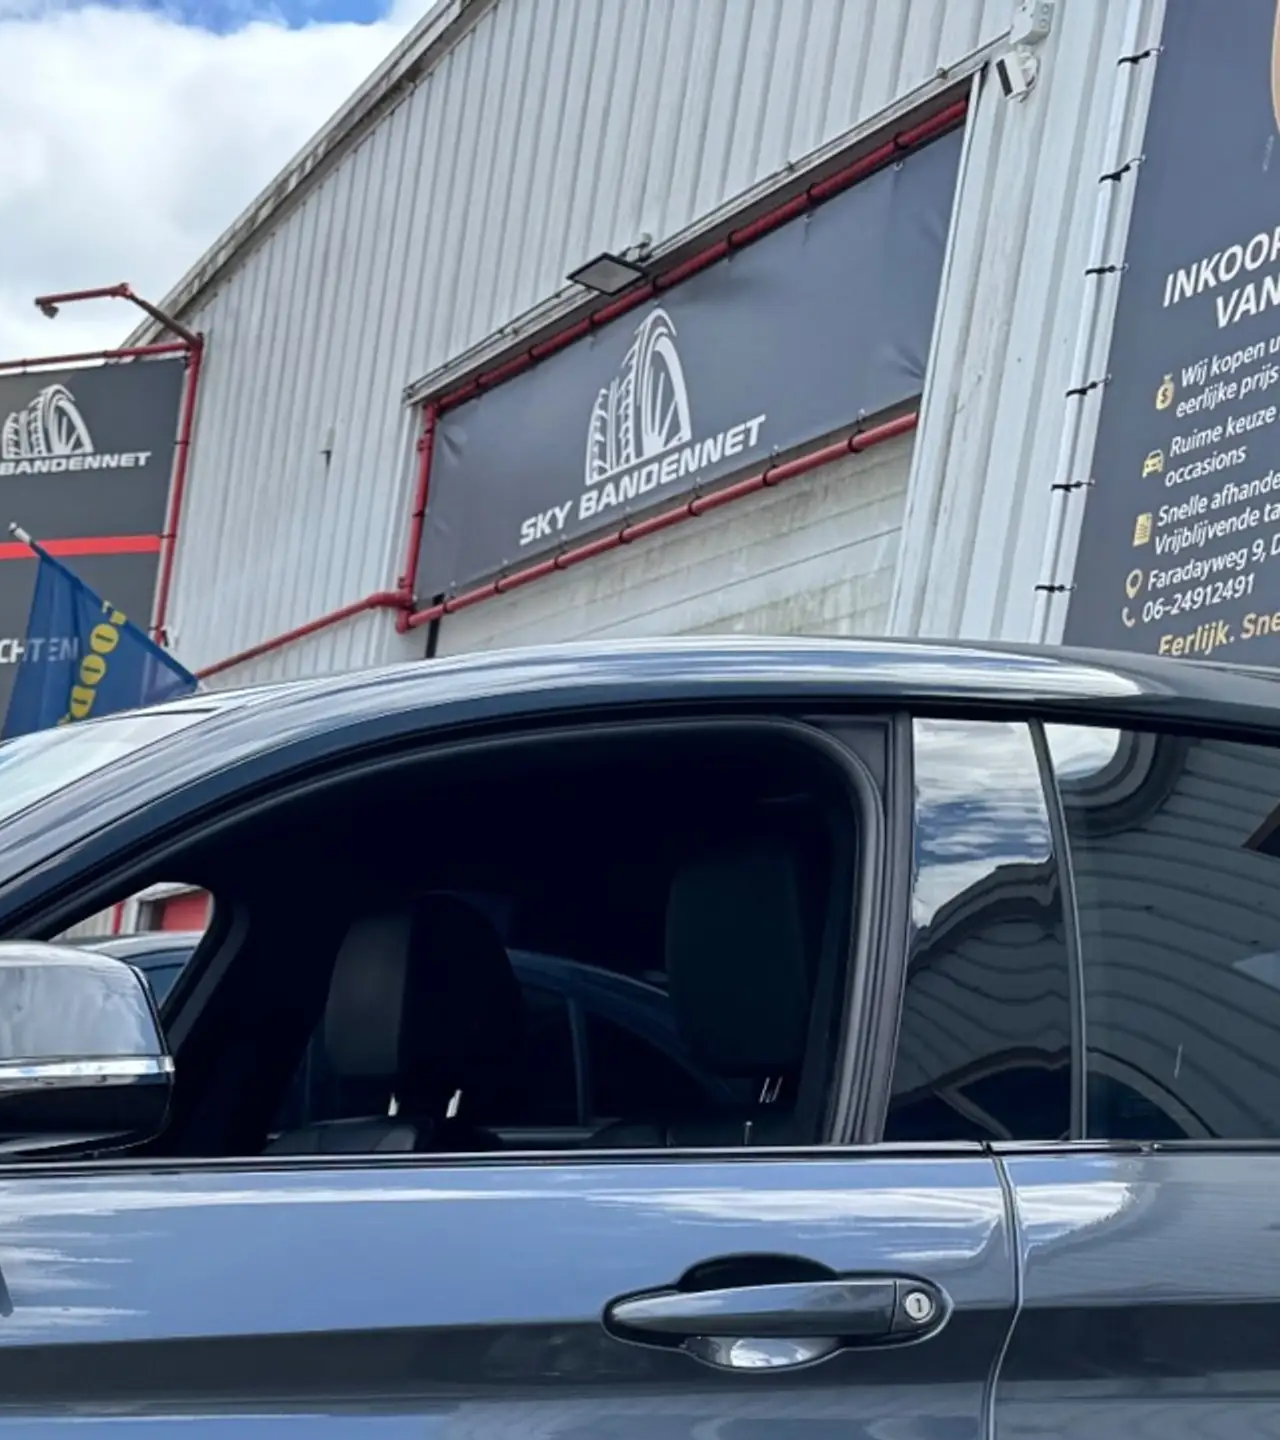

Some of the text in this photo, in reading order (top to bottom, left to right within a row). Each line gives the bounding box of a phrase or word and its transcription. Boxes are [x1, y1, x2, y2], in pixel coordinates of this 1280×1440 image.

[1181, 358, 1209, 388] Wij
[1210, 341, 1266, 377] kopen
[1175, 363, 1280, 418] eerlijke prijs
[1170, 405, 1277, 457] Ruime keuze
[519, 414, 766, 547] SKY BANDENNET
[1165, 446, 1247, 487] occasions
[1155, 506, 1261, 555] Vrijblijvende
[1157, 494, 1208, 527] Snelle
[1148, 547, 1249, 591] Faradayweg
[1252, 538, 1267, 563] 9,
[1142, 571, 1256, 623] 06-24912491
[1158, 620, 1236, 656] Eerlijk.
